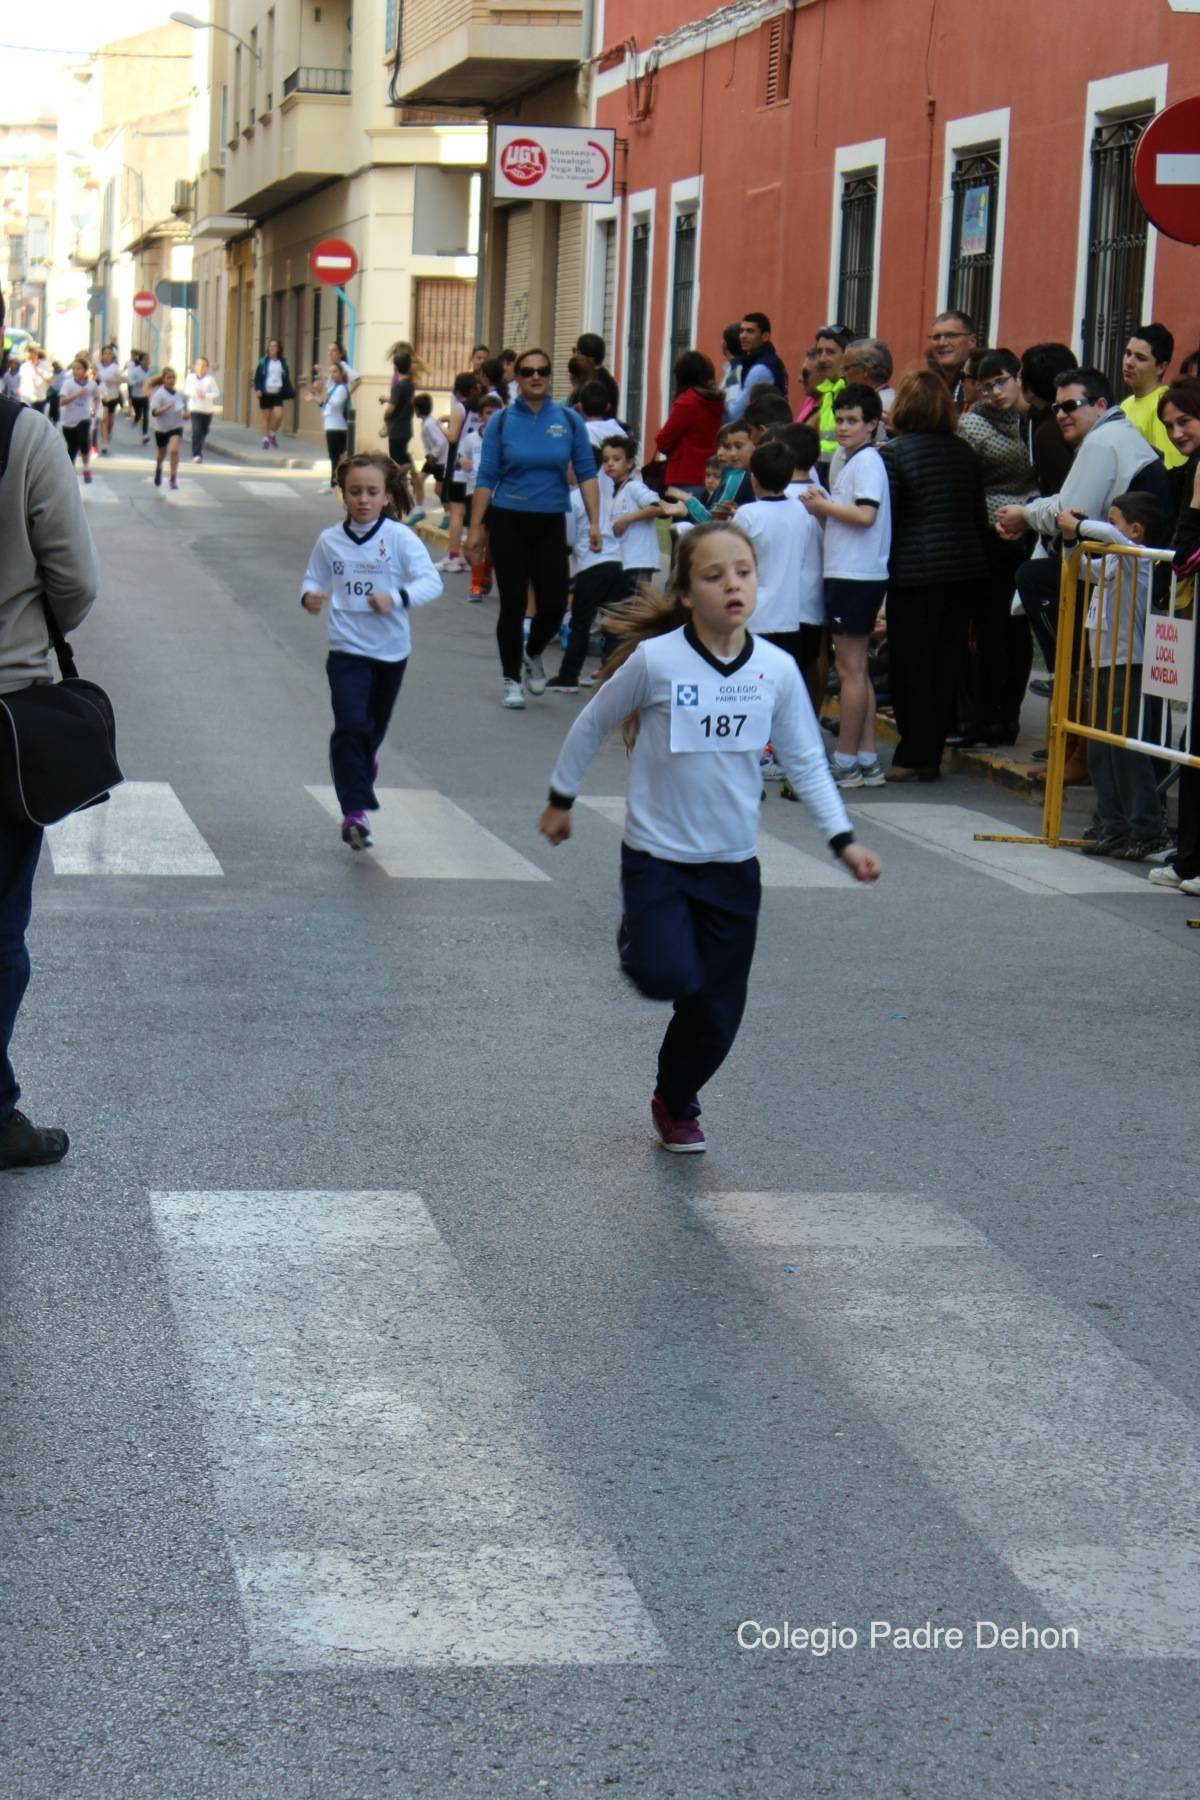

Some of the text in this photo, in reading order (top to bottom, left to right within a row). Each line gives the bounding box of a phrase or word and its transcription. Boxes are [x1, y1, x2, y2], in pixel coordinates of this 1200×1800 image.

[505, 145, 542, 167] UGT
[345, 581, 374, 596] 162
[1155, 645, 1175, 664] LOCAL
[1151, 664, 1178, 686] NOVELDA
[719, 685, 758, 694] COLEGIO
[700, 714, 748, 738] 187
